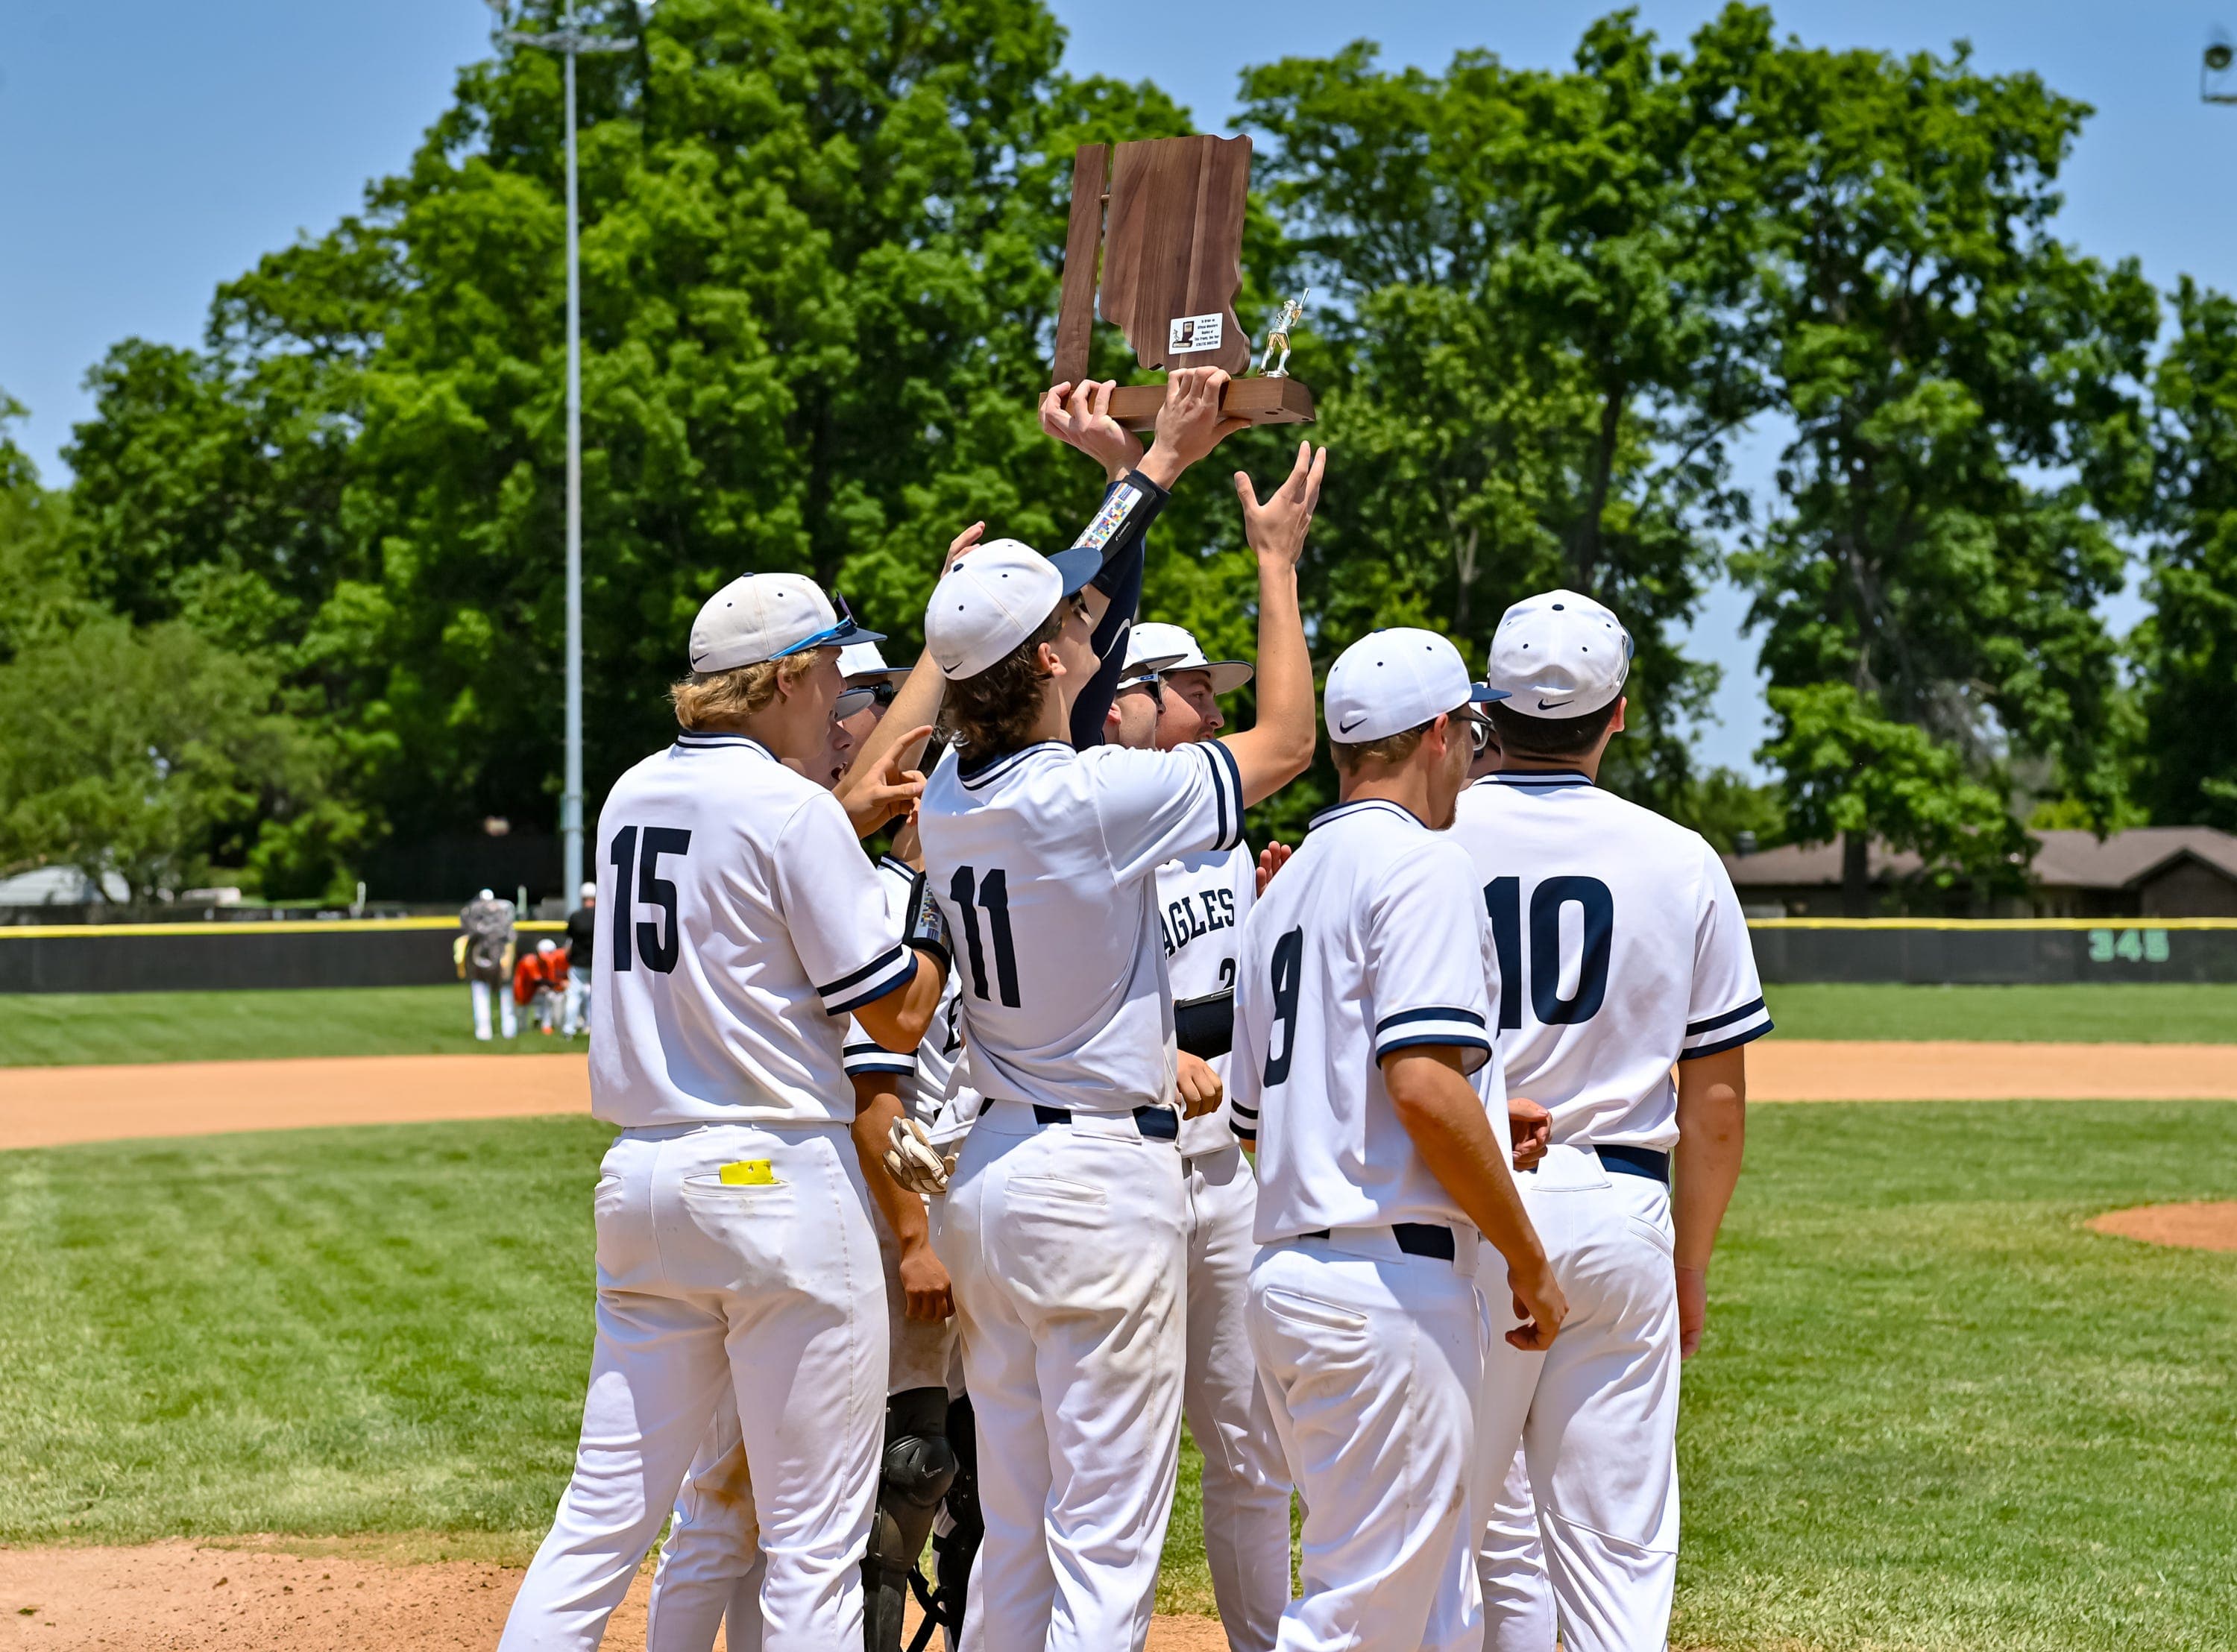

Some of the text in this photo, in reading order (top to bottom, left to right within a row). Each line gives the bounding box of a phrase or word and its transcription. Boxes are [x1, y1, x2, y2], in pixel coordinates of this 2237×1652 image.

[611, 826, 692, 974] 15
[950, 866, 1021, 1008] 11
[1160, 889, 1235, 960] AGLES
[1484, 876, 1614, 1030] 10
[1264, 925, 1303, 1088] 9
